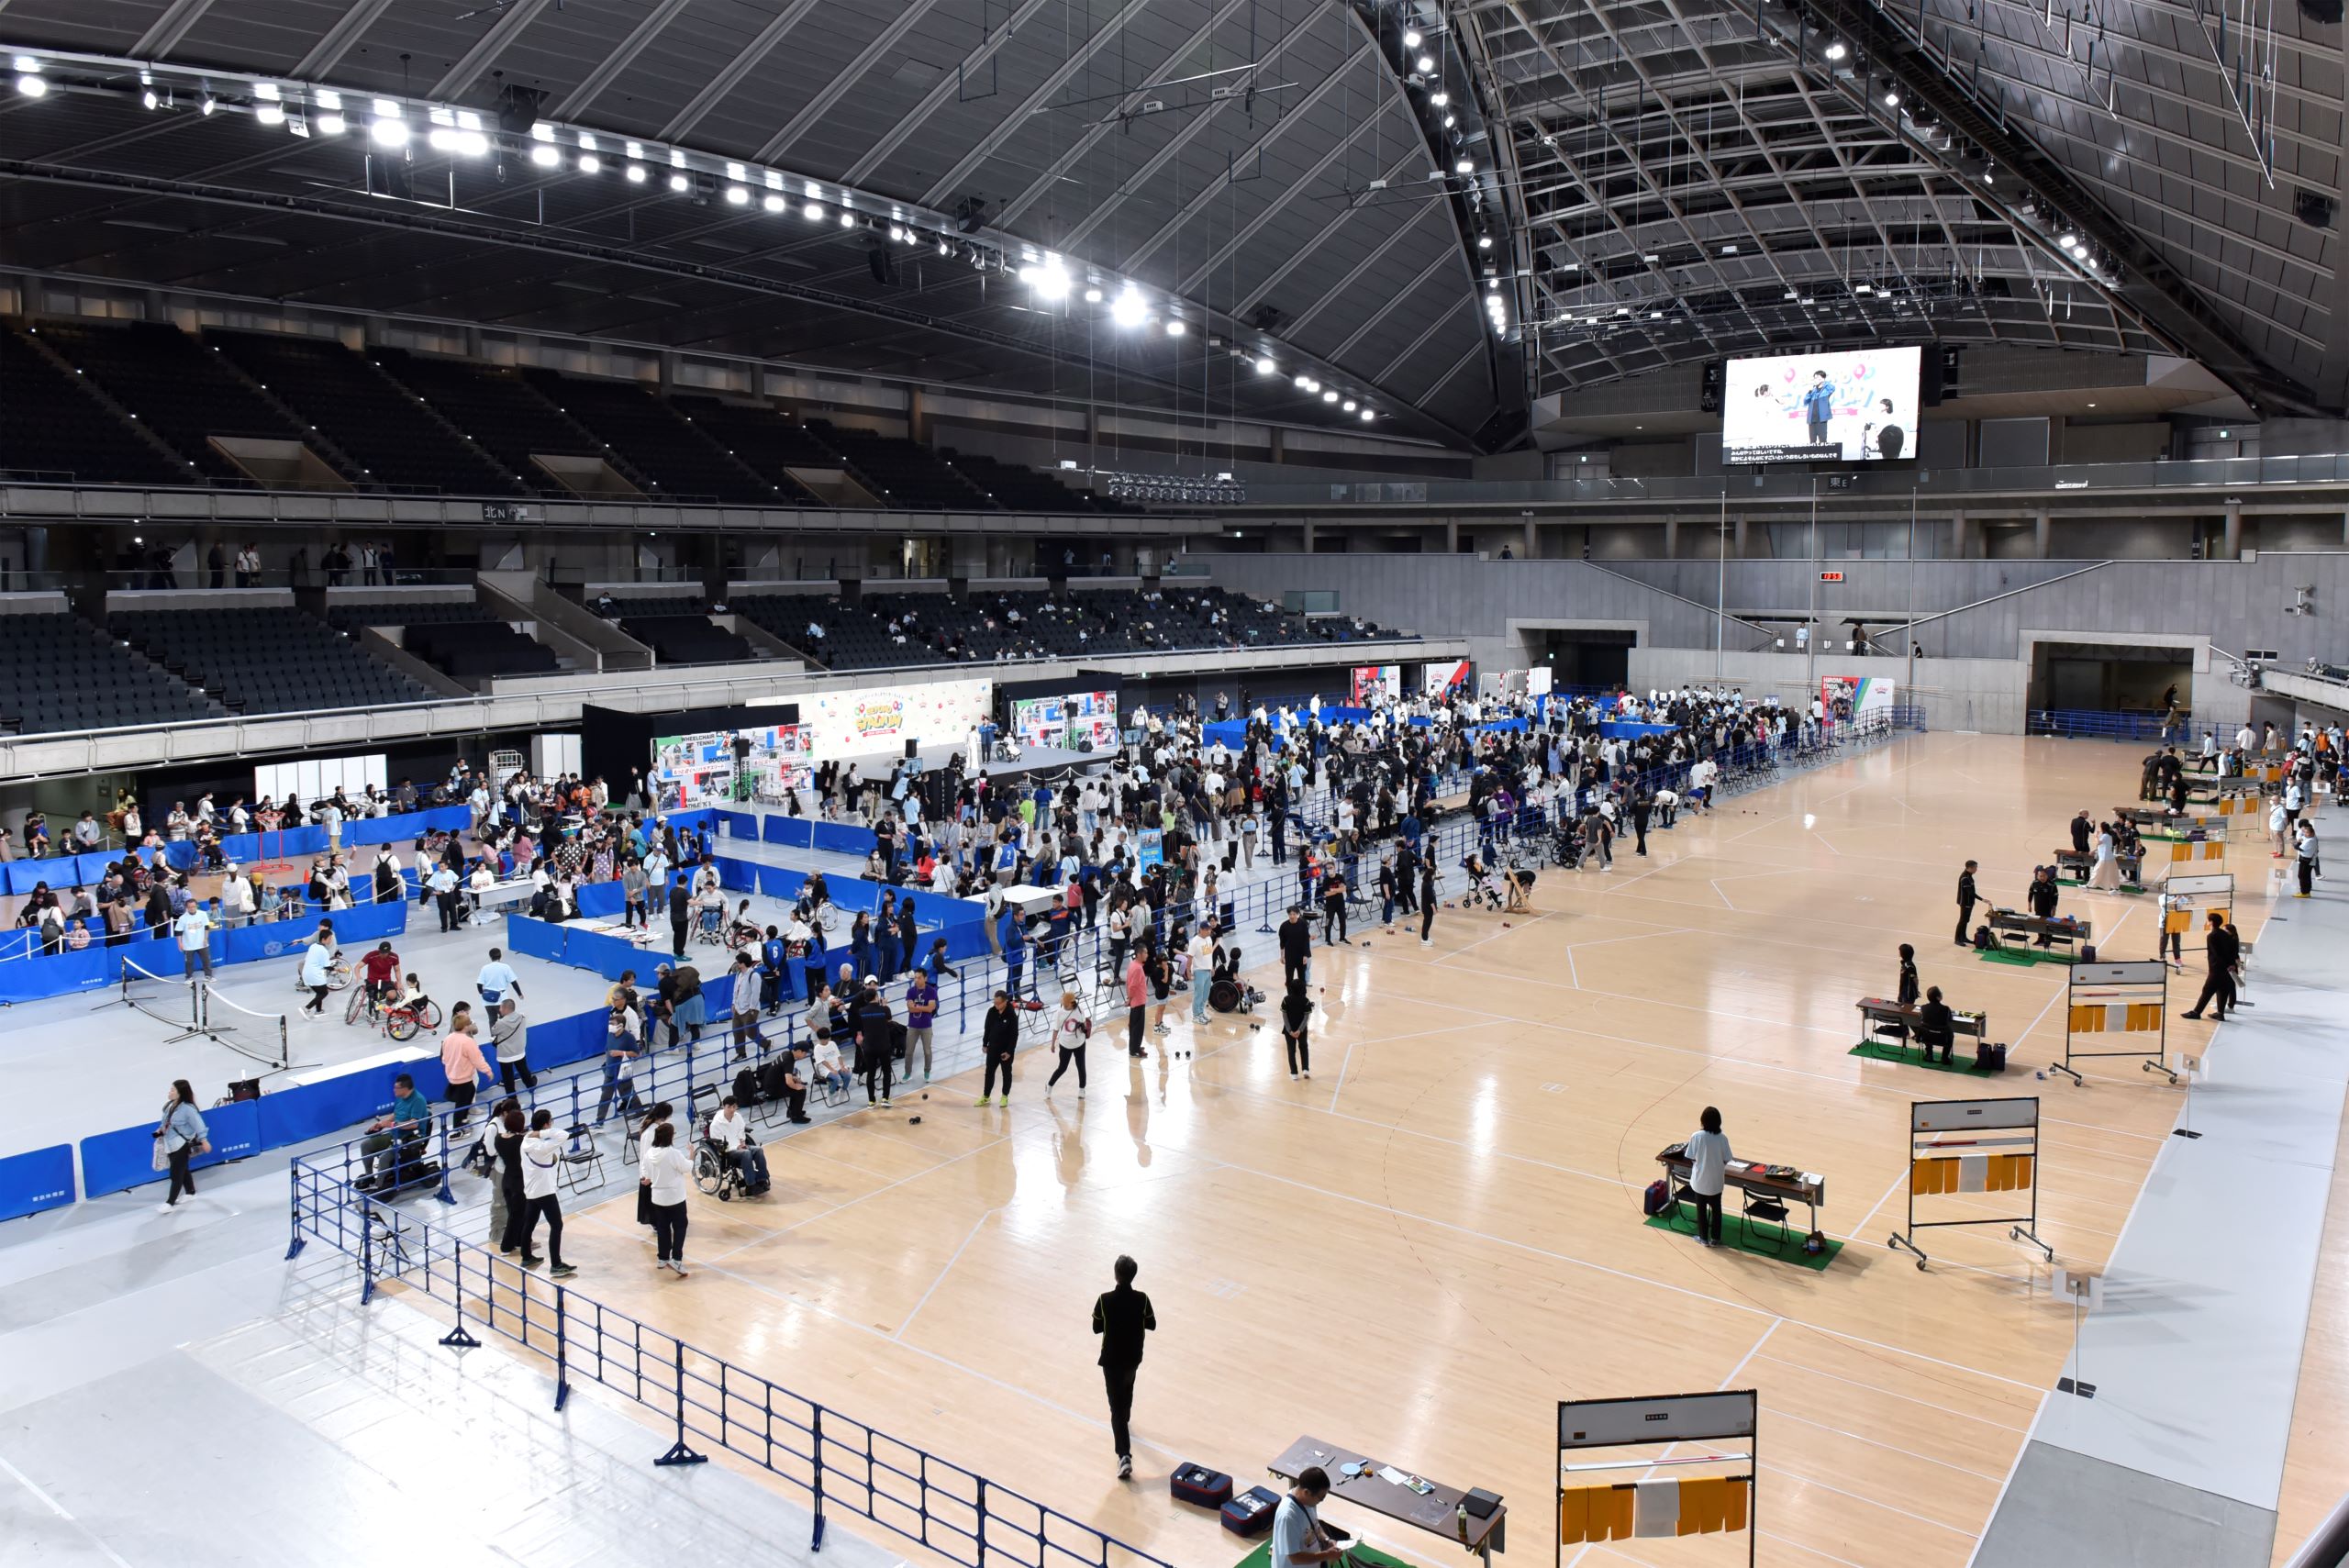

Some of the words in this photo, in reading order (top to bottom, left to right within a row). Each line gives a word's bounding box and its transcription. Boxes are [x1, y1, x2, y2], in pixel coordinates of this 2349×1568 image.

[1830, 477, 1841, 488] 東
[1842, 479, 1848, 487] E
[484, 506, 496, 518] 北
[497, 508, 506, 518] N
[681, 734, 716, 742] WHEELCHAIR
[708, 754, 731, 764] BOCCIA
[1007, 850, 1011, 860] 2
[773, 945, 779, 959] 6
